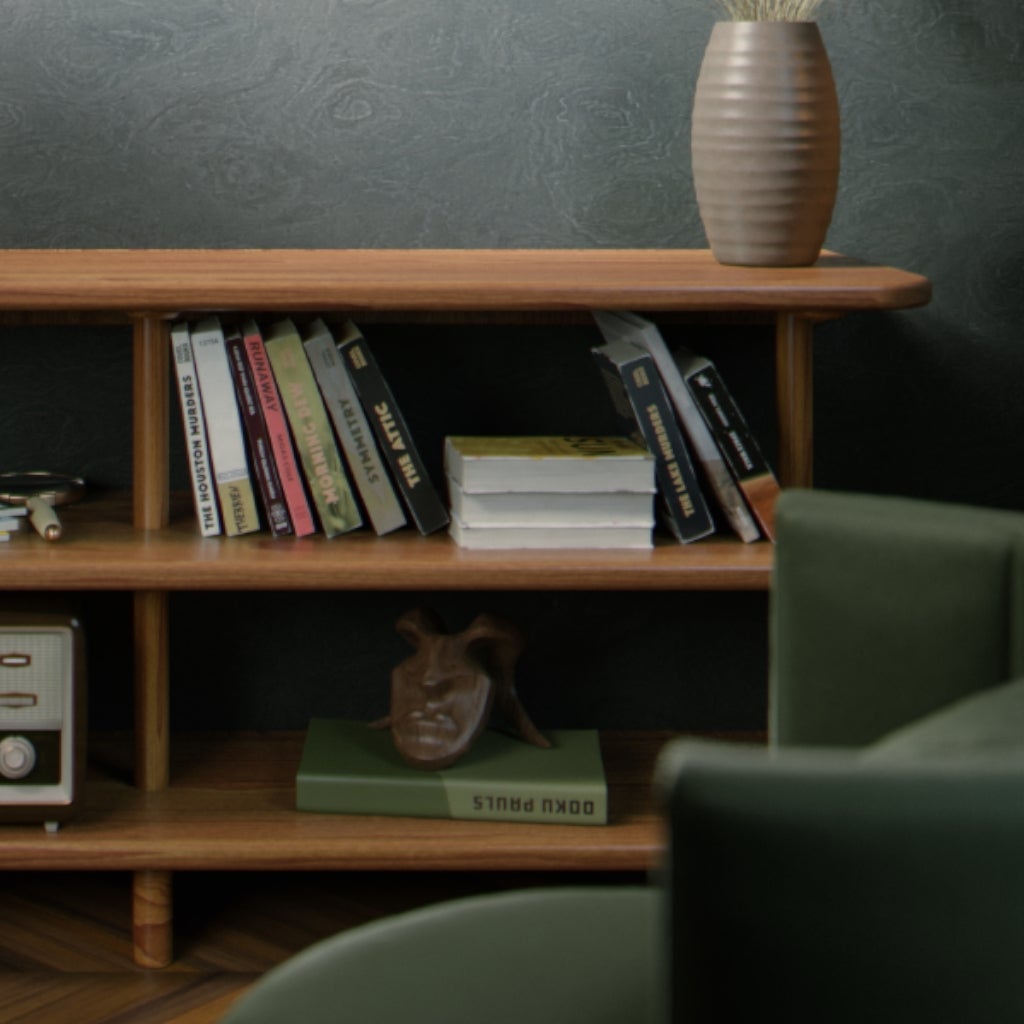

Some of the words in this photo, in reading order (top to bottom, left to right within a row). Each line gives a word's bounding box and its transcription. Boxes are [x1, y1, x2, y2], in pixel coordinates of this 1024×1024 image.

[250, 341, 279, 412] RUNAWAY
[288, 381, 312, 421] DEW
[182, 375, 201, 437] MURDERS
[374, 401, 399, 451] ATTIC
[339, 398, 378, 484] SYMMETRY
[646, 403, 675, 462] MURDERS
[191, 439, 209, 503] HOUSTON
[302, 423, 340, 505] MORNING
[398, 452, 422, 489] THE
[203, 506, 213, 531] THE
[678, 490, 695, 519] THE
[473, 796, 534, 813] PAULS
[542, 798, 595, 815] DOKU
